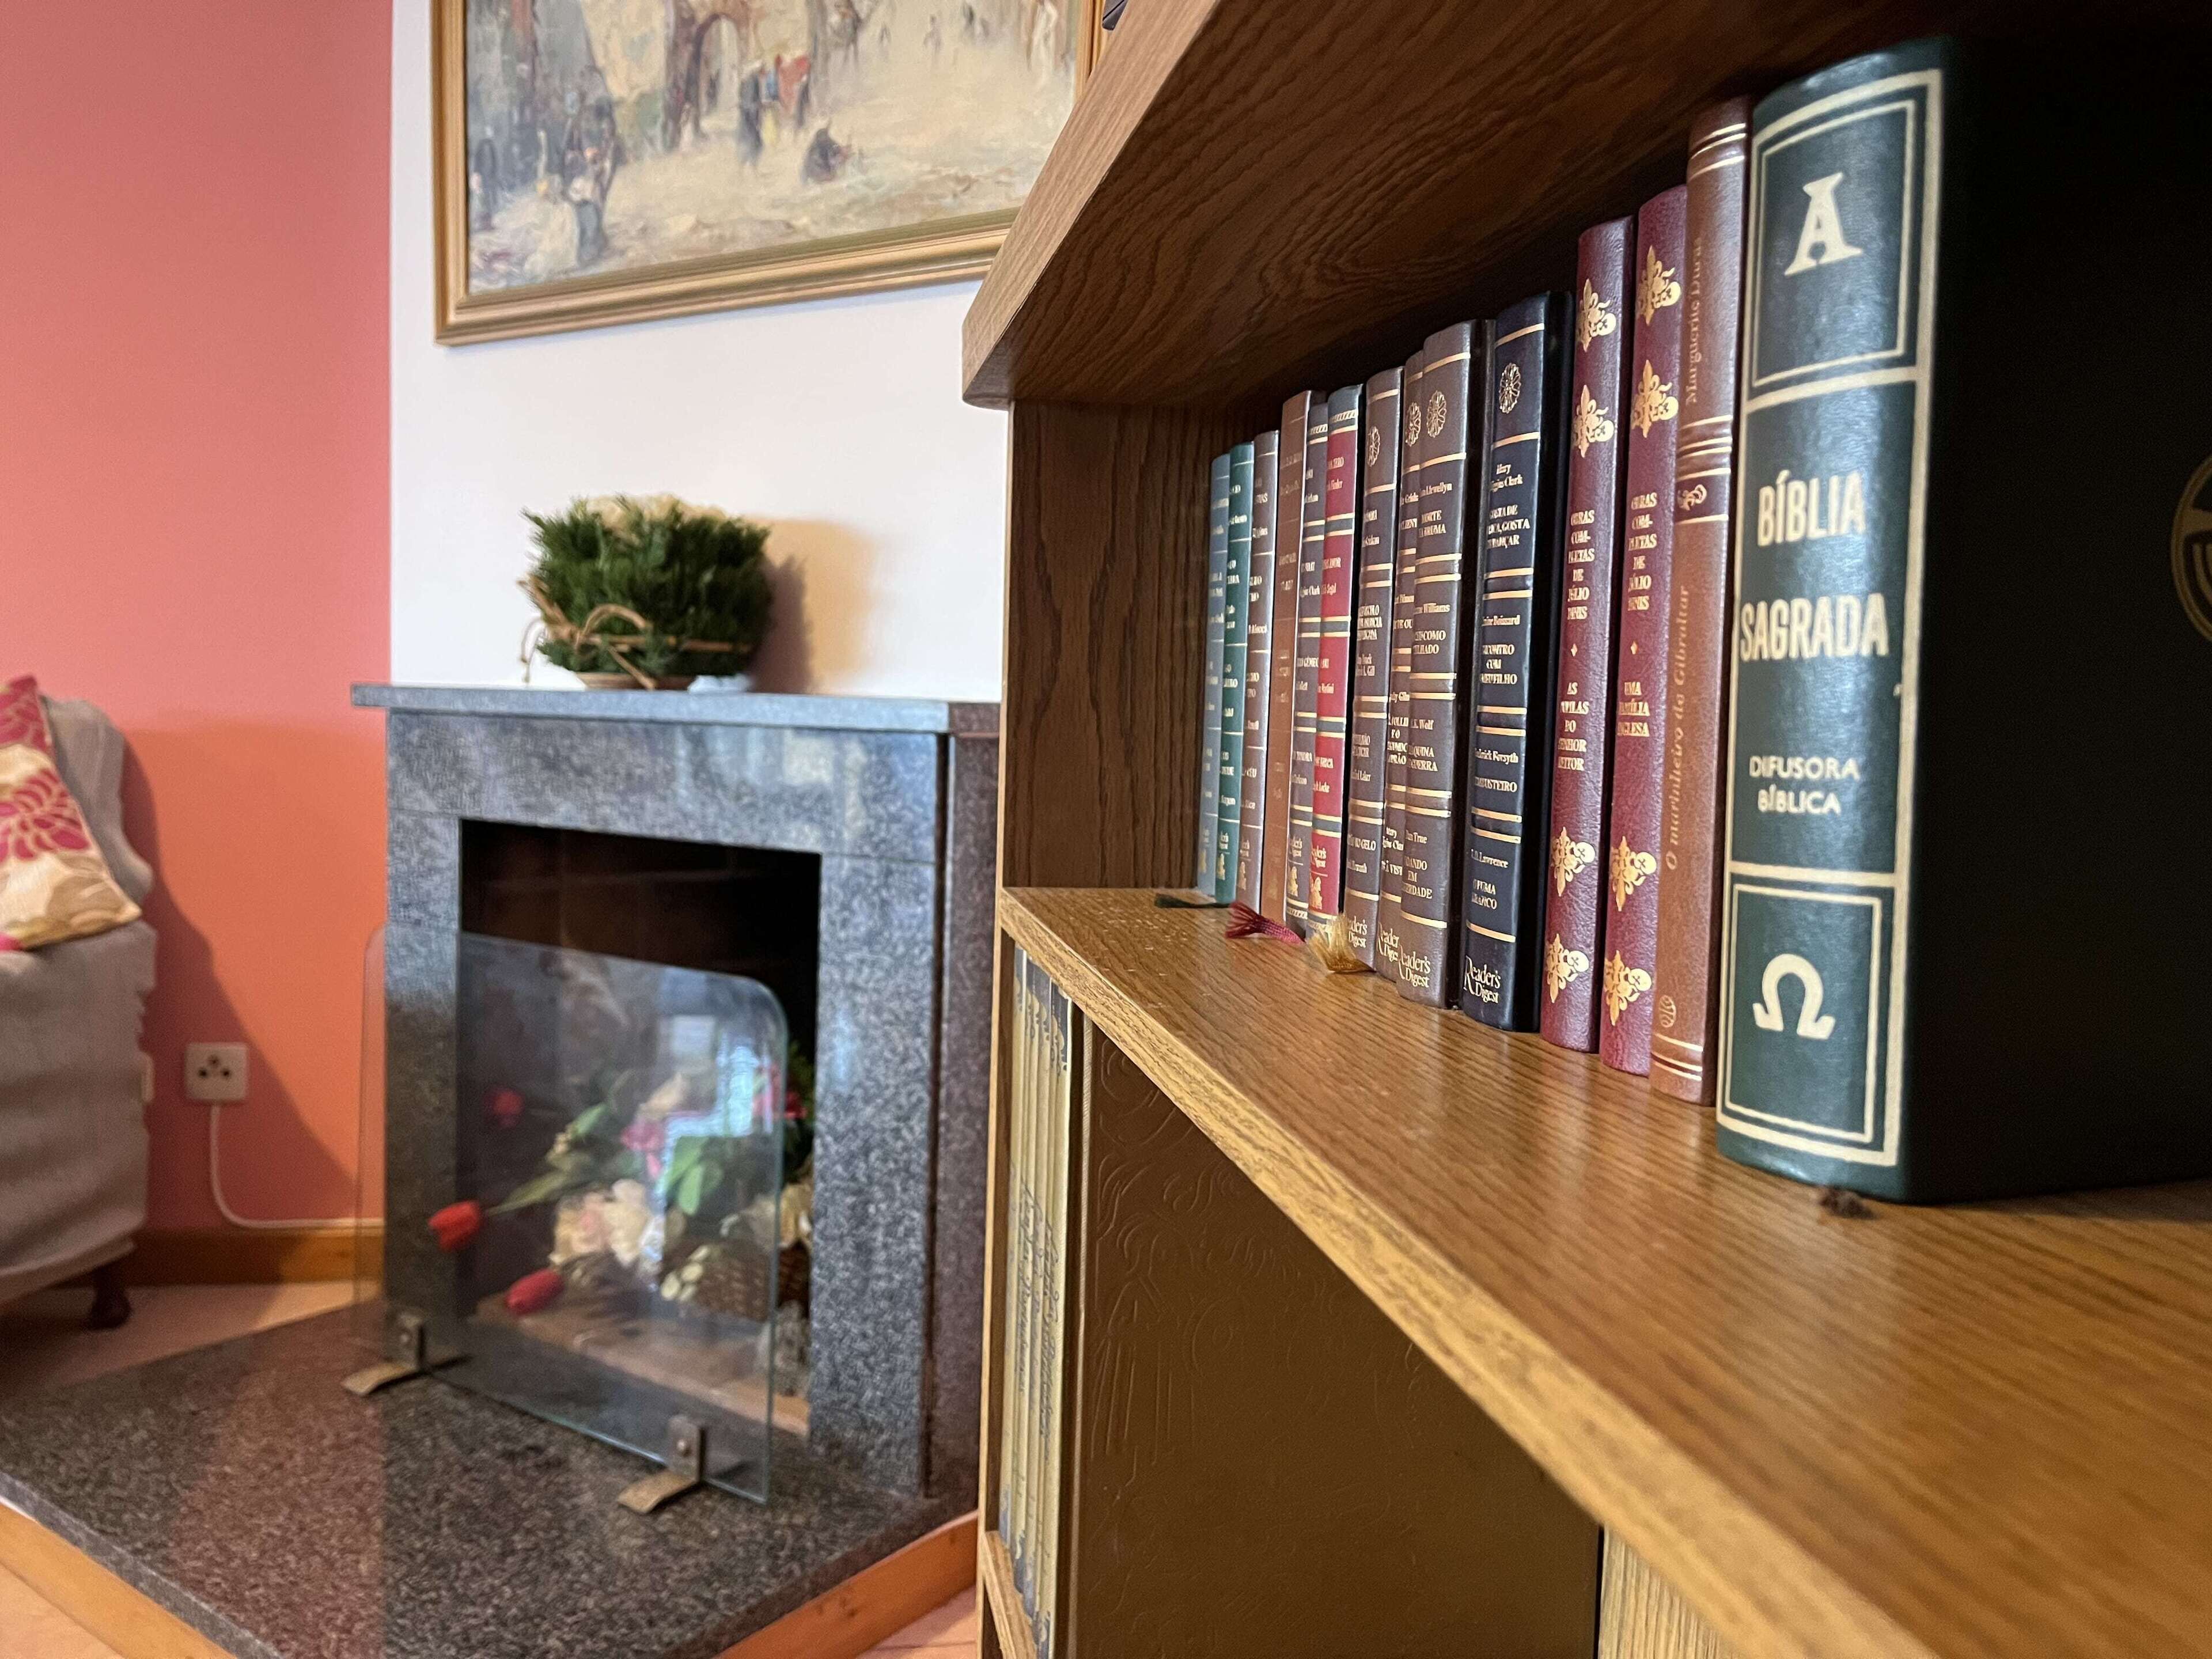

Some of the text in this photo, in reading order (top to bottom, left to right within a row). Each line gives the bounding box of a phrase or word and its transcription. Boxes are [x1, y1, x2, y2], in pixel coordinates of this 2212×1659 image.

[1785, 172, 1863, 276] A
[1685, 300, 1702, 406] Marguerite
[1758, 469, 1866, 546] BÍBLIA
[1573, 569, 1584, 581] DE
[1740, 592, 1890, 662] SAGRADA
[1567, 681, 1578, 695] AS
[1665, 586, 1690, 870] O marinheiro de Gibraltar
[1493, 751, 1519, 765] Forsyth
[1749, 755, 1860, 781] DIFUSORA
[1757, 783, 1842, 815] BÍBLICA
[1479, 851, 1509, 869] Lawrence
[1405, 968, 1430, 988] Digest
[1463, 955, 1502, 995] Reader's
[1475, 981, 1500, 1004] Digest
